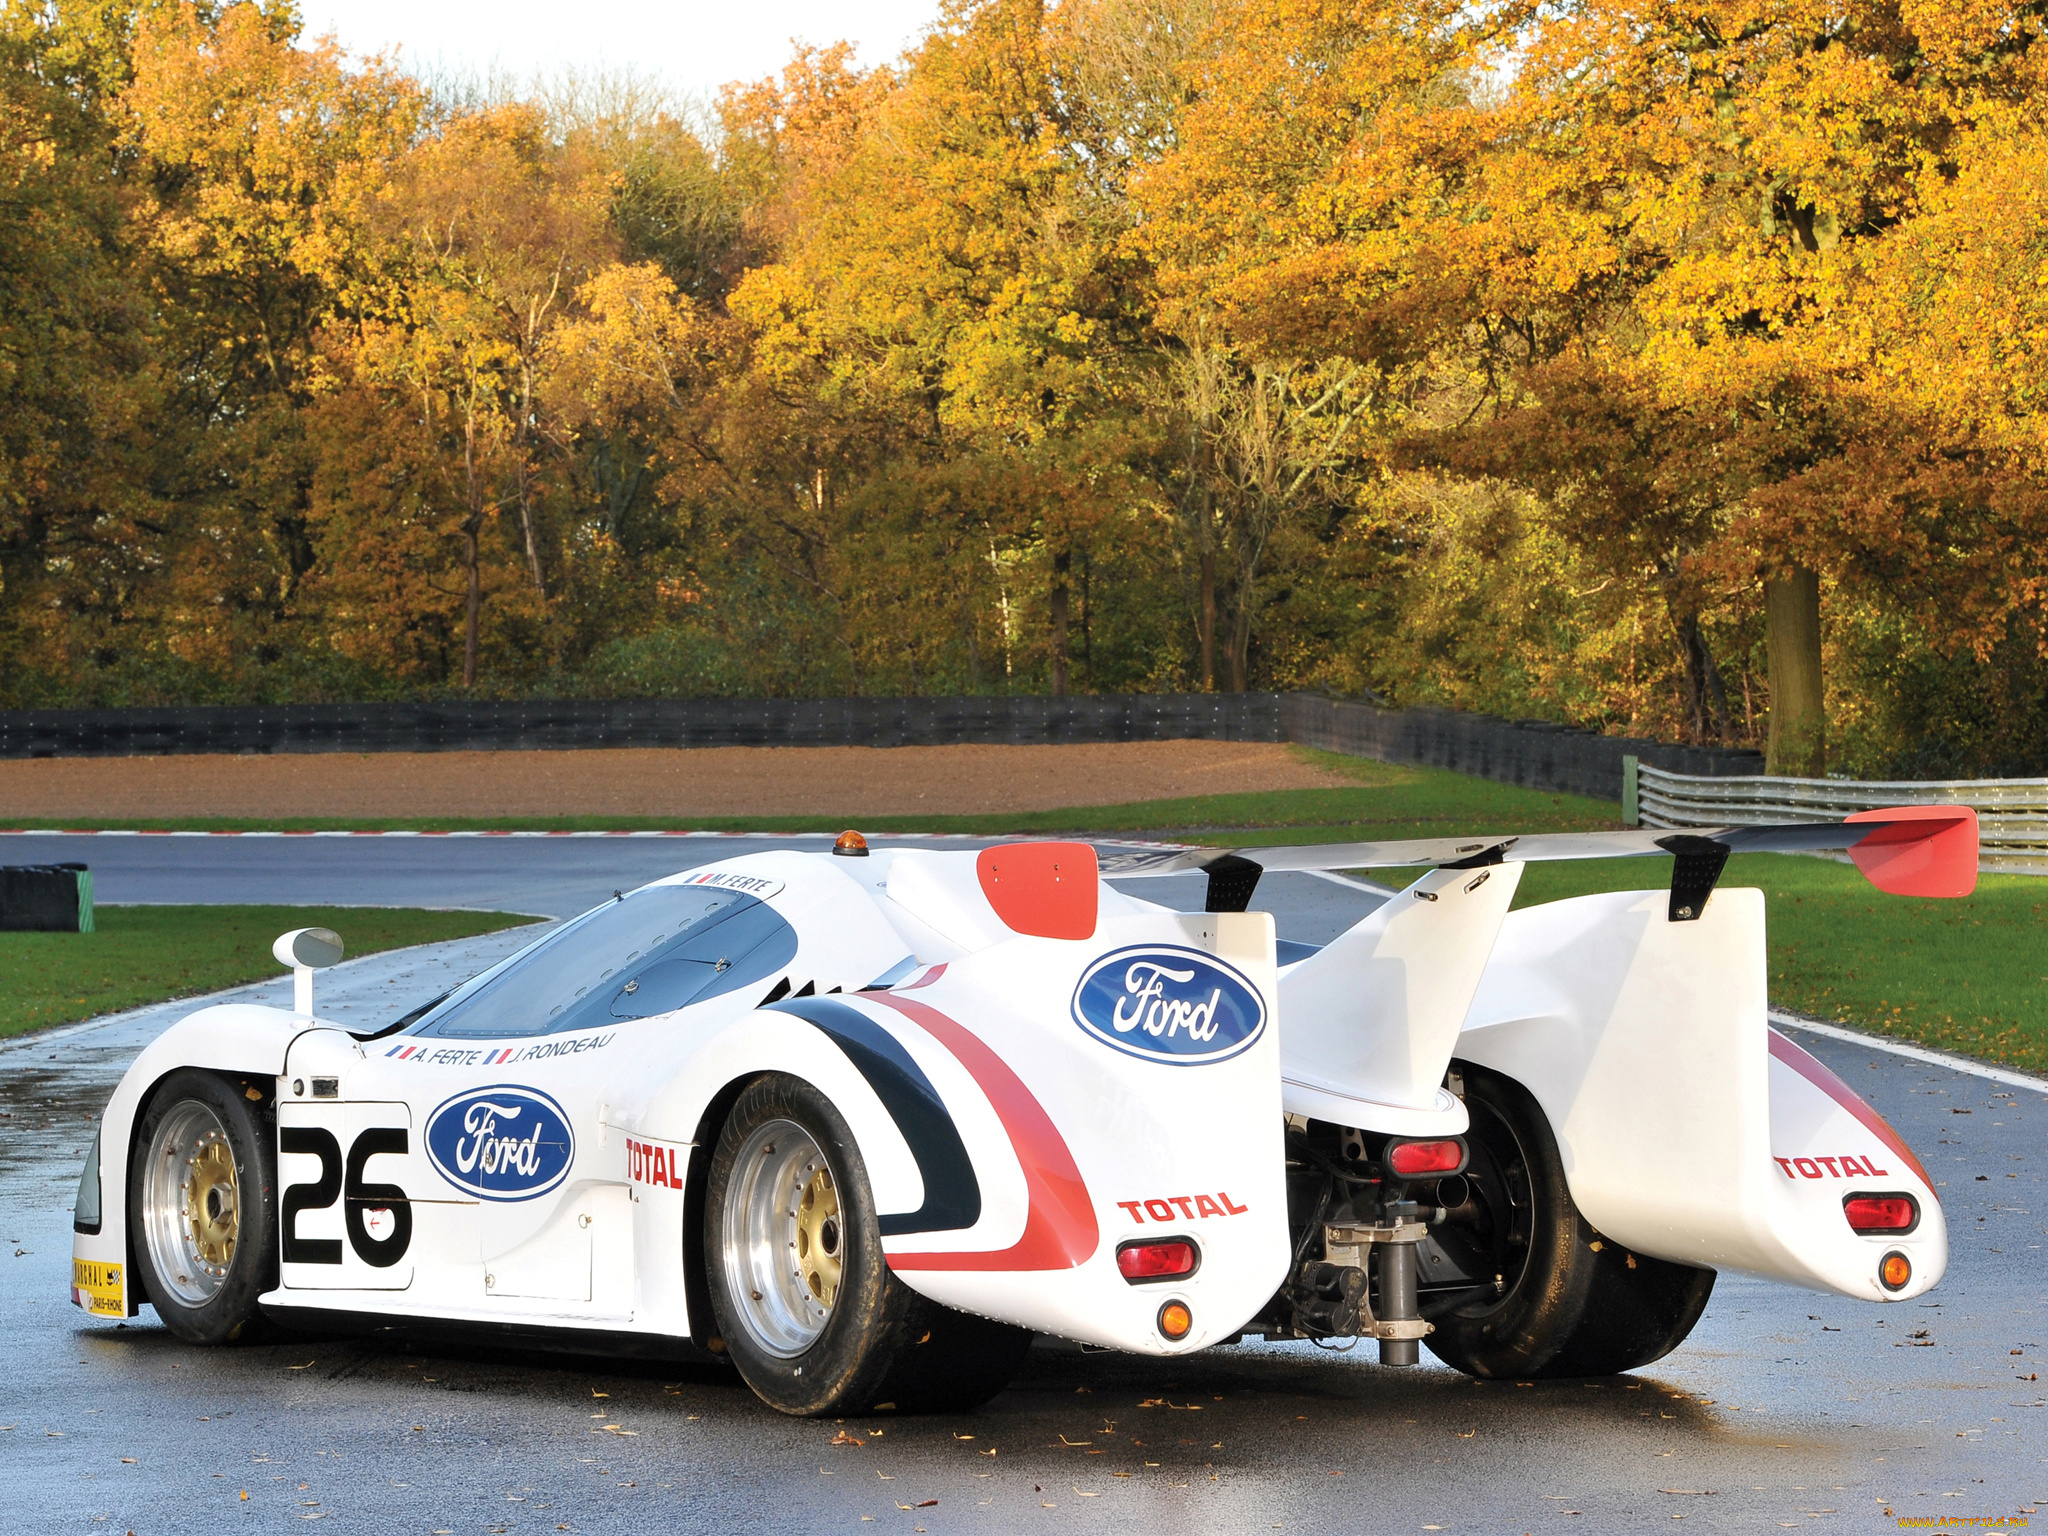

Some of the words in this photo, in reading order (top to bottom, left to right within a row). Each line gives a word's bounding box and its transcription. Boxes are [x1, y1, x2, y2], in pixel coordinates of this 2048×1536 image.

[1113, 961, 1221, 1042] Ford
[456, 1101, 542, 1177] Ford
[626, 1138, 683, 1190] TOTAL
[1773, 1155, 1889, 1180] TOTAL
[280, 1127, 413, 1268] 26
[1116, 1192, 1249, 1224] TOTAL
